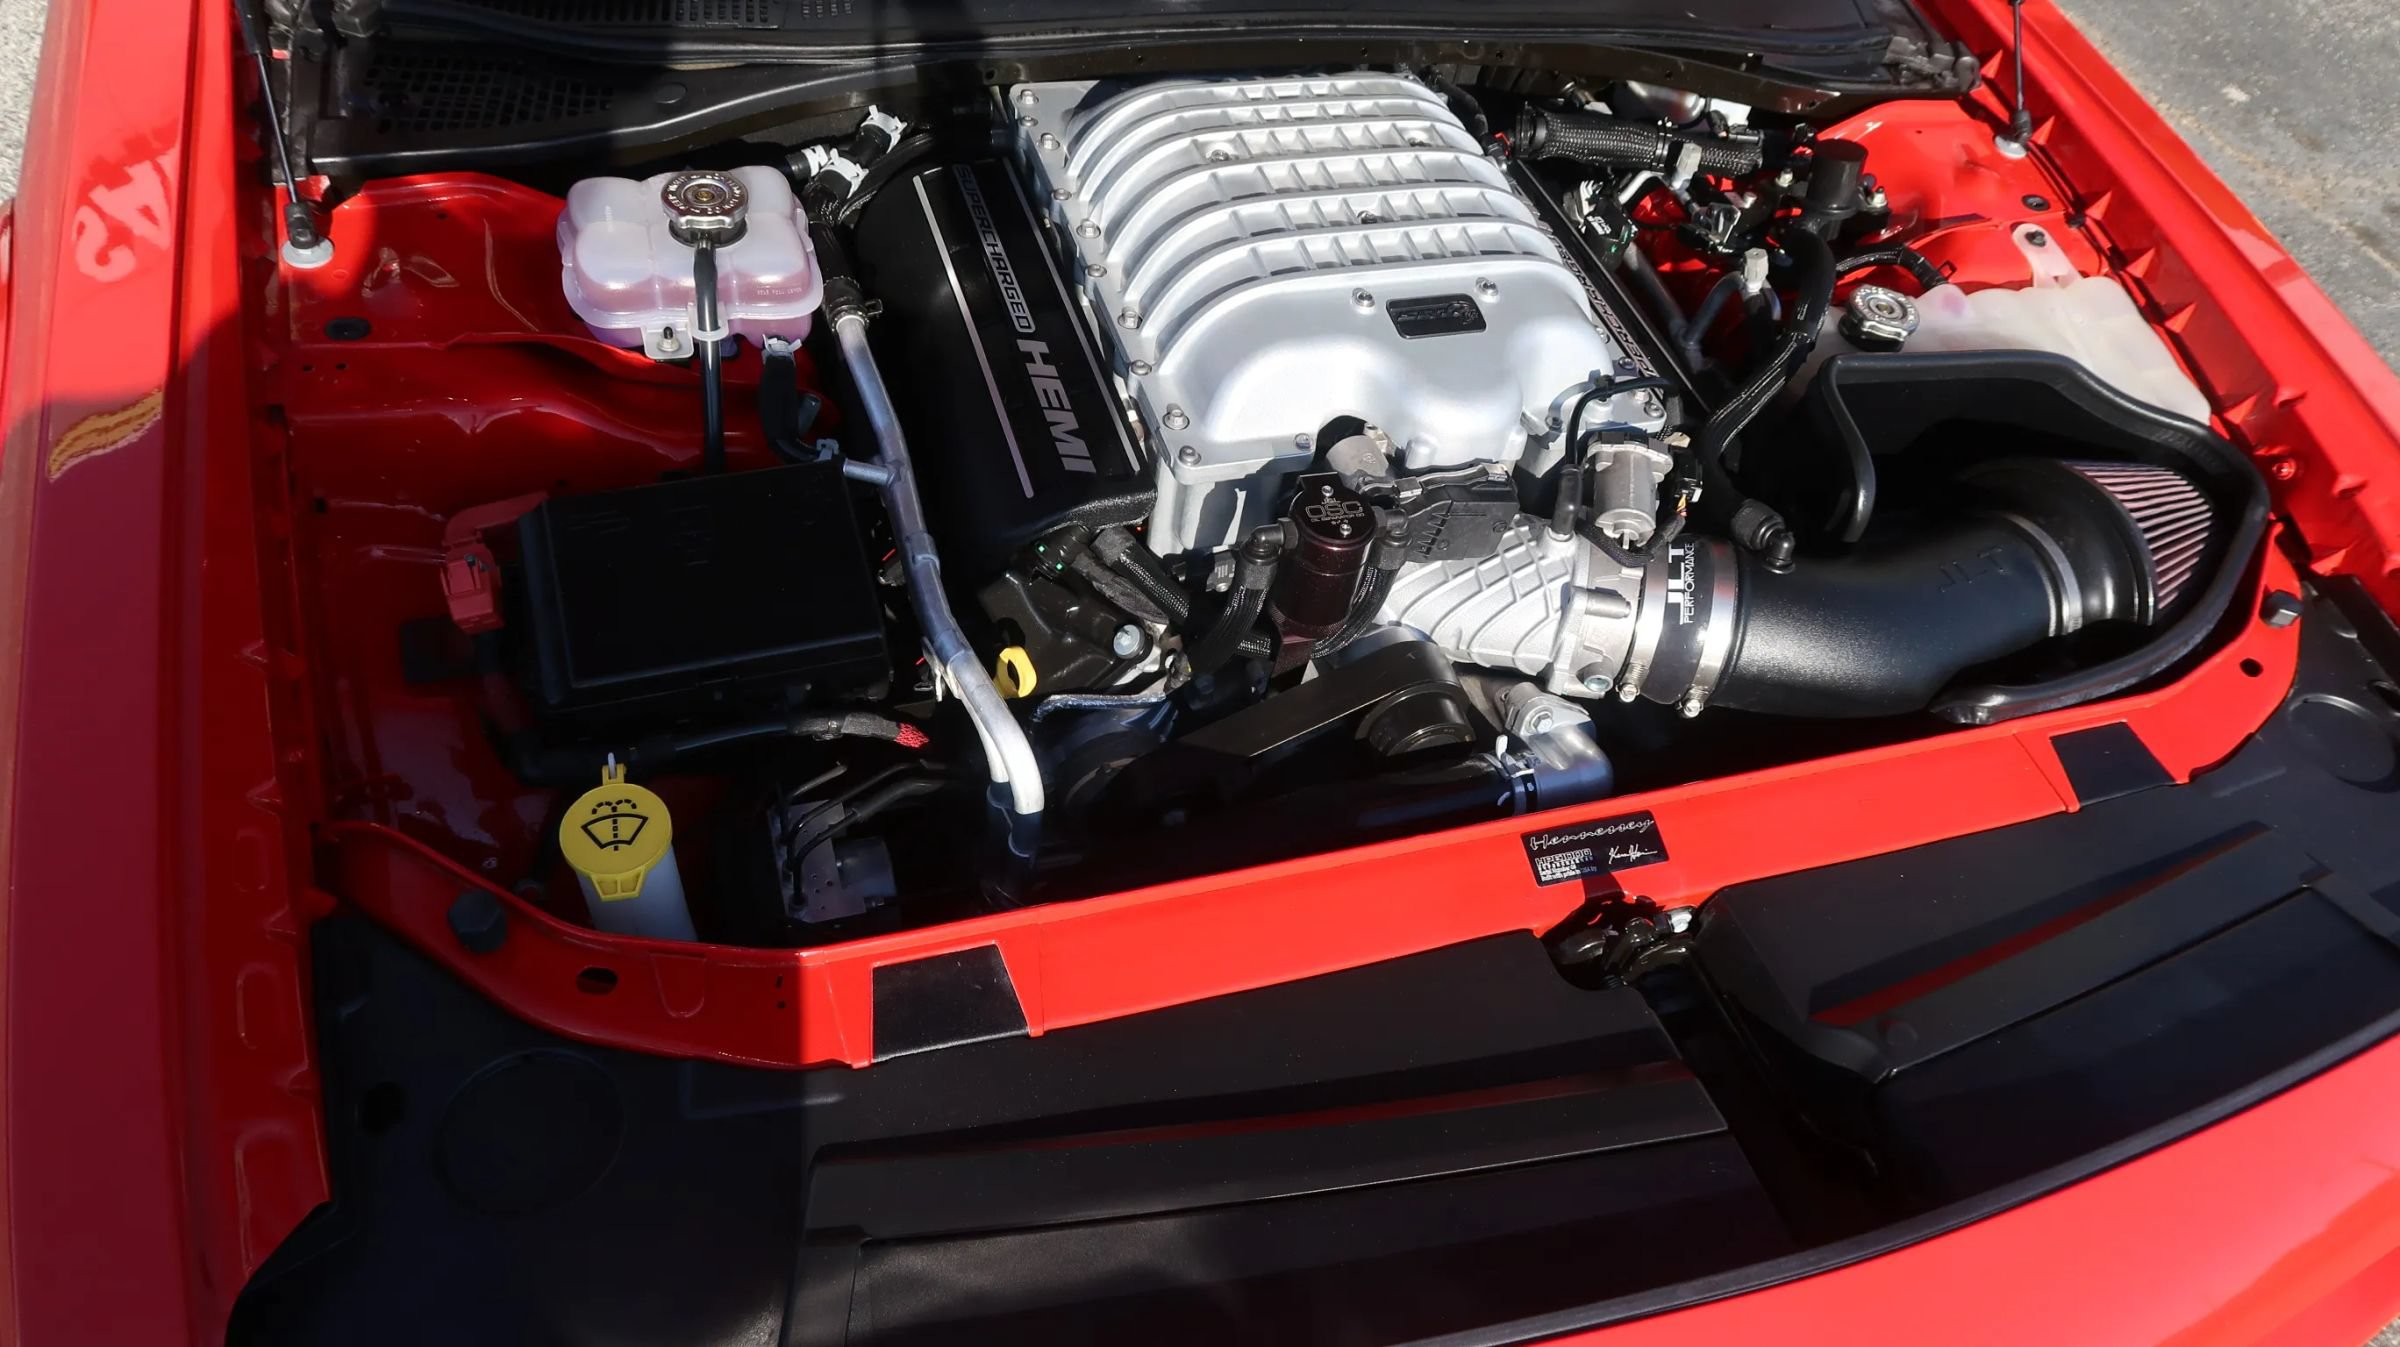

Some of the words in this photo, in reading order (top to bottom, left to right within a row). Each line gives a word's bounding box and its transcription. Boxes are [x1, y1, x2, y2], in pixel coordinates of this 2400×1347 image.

[957, 166, 1032, 329] SUPERCHARGED
[1016, 339, 1096, 473] HEMI
[1305, 501, 1363, 518] OSC
[1667, 543, 1685, 626] JLT
[1684, 543, 1696, 624] PERFORMANCE
[1530, 819, 1655, 850] Hennessey
